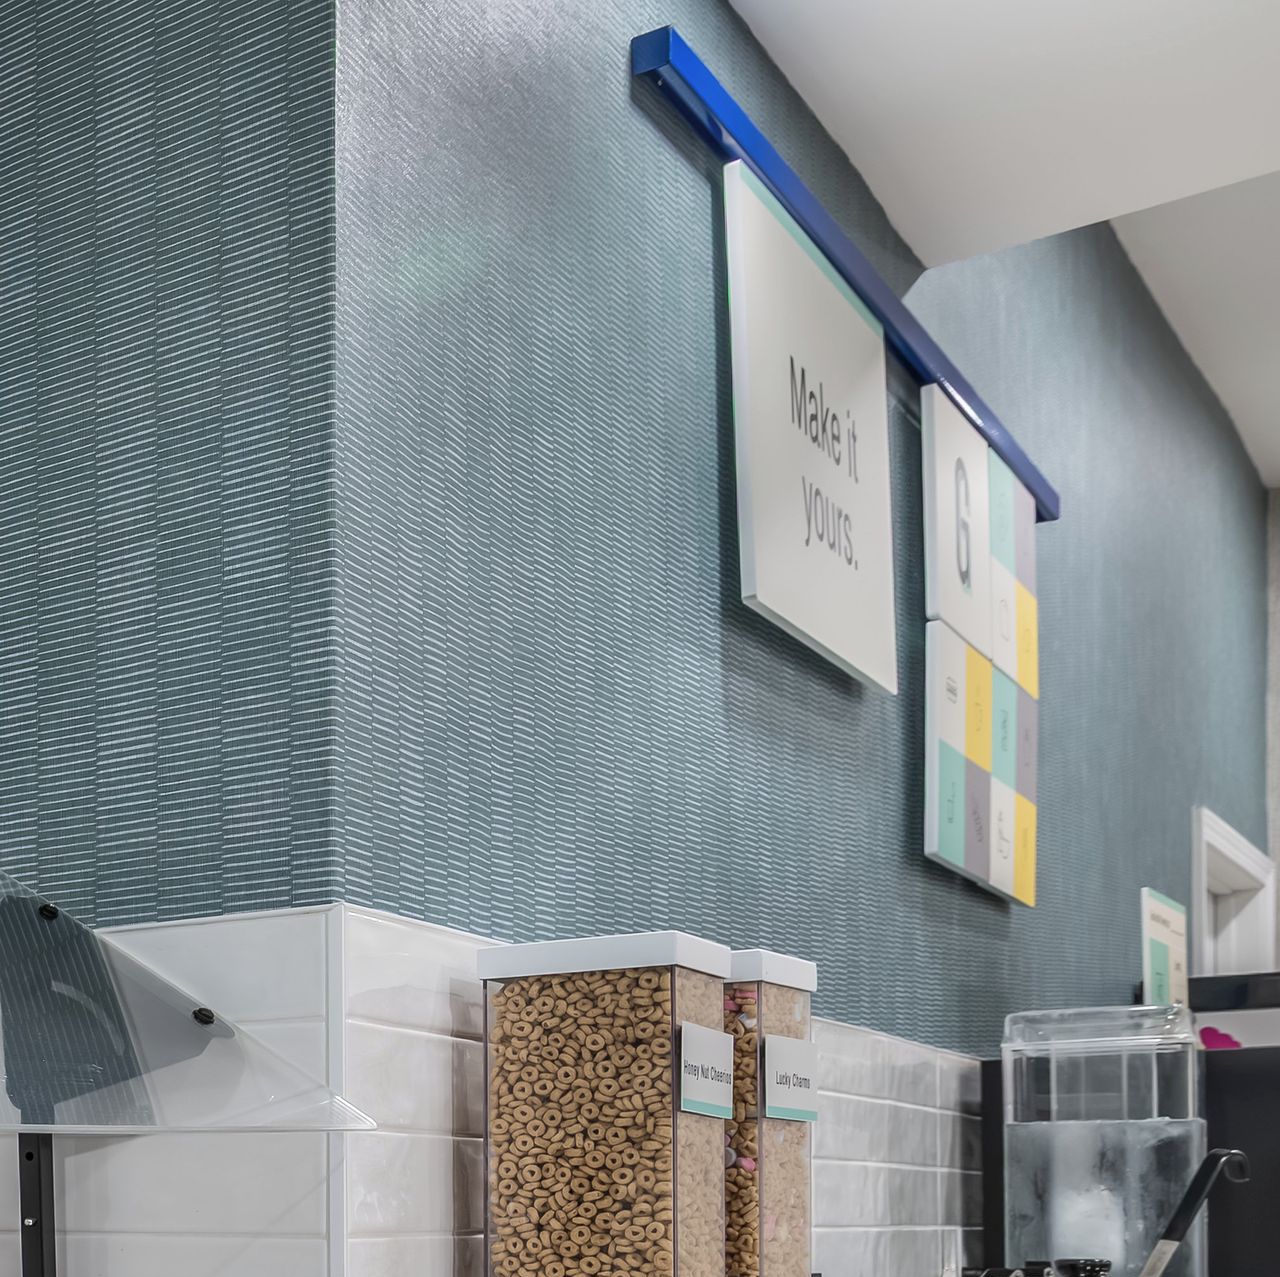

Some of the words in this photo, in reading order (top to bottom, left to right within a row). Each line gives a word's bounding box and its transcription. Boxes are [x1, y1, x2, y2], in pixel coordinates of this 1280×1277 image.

[789, 355, 842, 467] Make
[846, 408, 859, 485] it
[801, 475, 859, 571] yours.
[775, 1071, 791, 1089] Lucky
[792, 1073, 811, 1089] Charms
